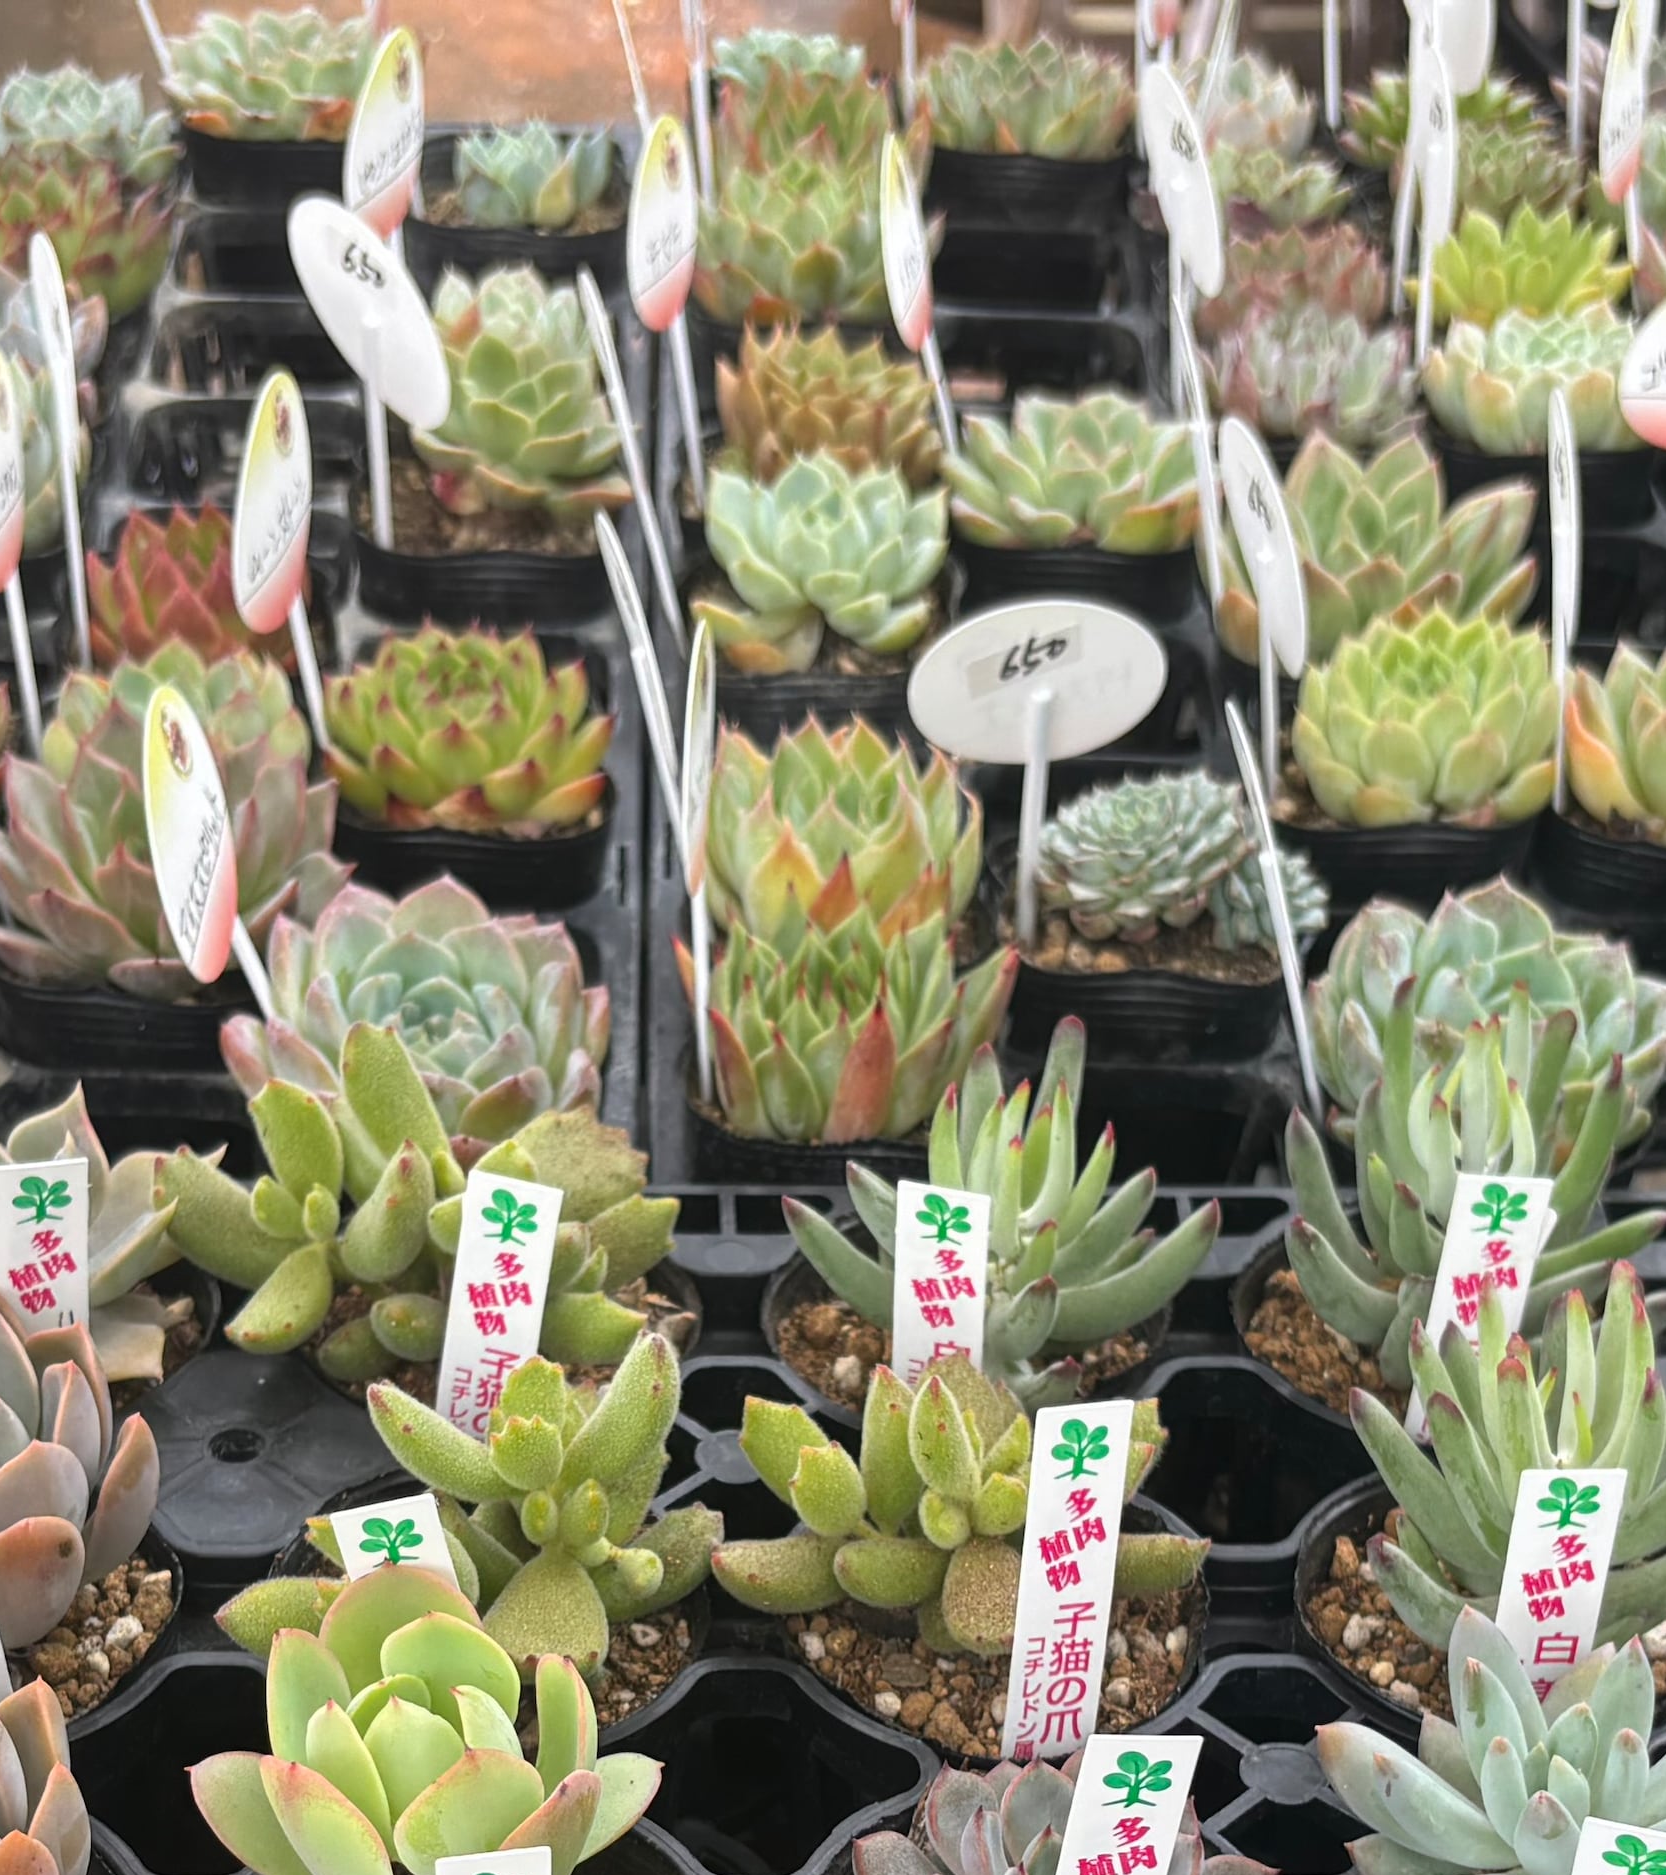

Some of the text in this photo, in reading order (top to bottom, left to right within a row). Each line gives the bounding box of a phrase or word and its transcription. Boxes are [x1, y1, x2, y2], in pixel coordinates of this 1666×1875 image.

[9, 1231, 77, 1313] 多肉植物
[468, 1252, 533, 1336] 多肉植物
[912, 1250, 977, 1328] 多肉植物
[1039, 1489, 1107, 1592] 多肉植物
[1522, 1535, 1595, 1623] 多肉植物
[1039, 1601, 1097, 1744] 子猫の爪
